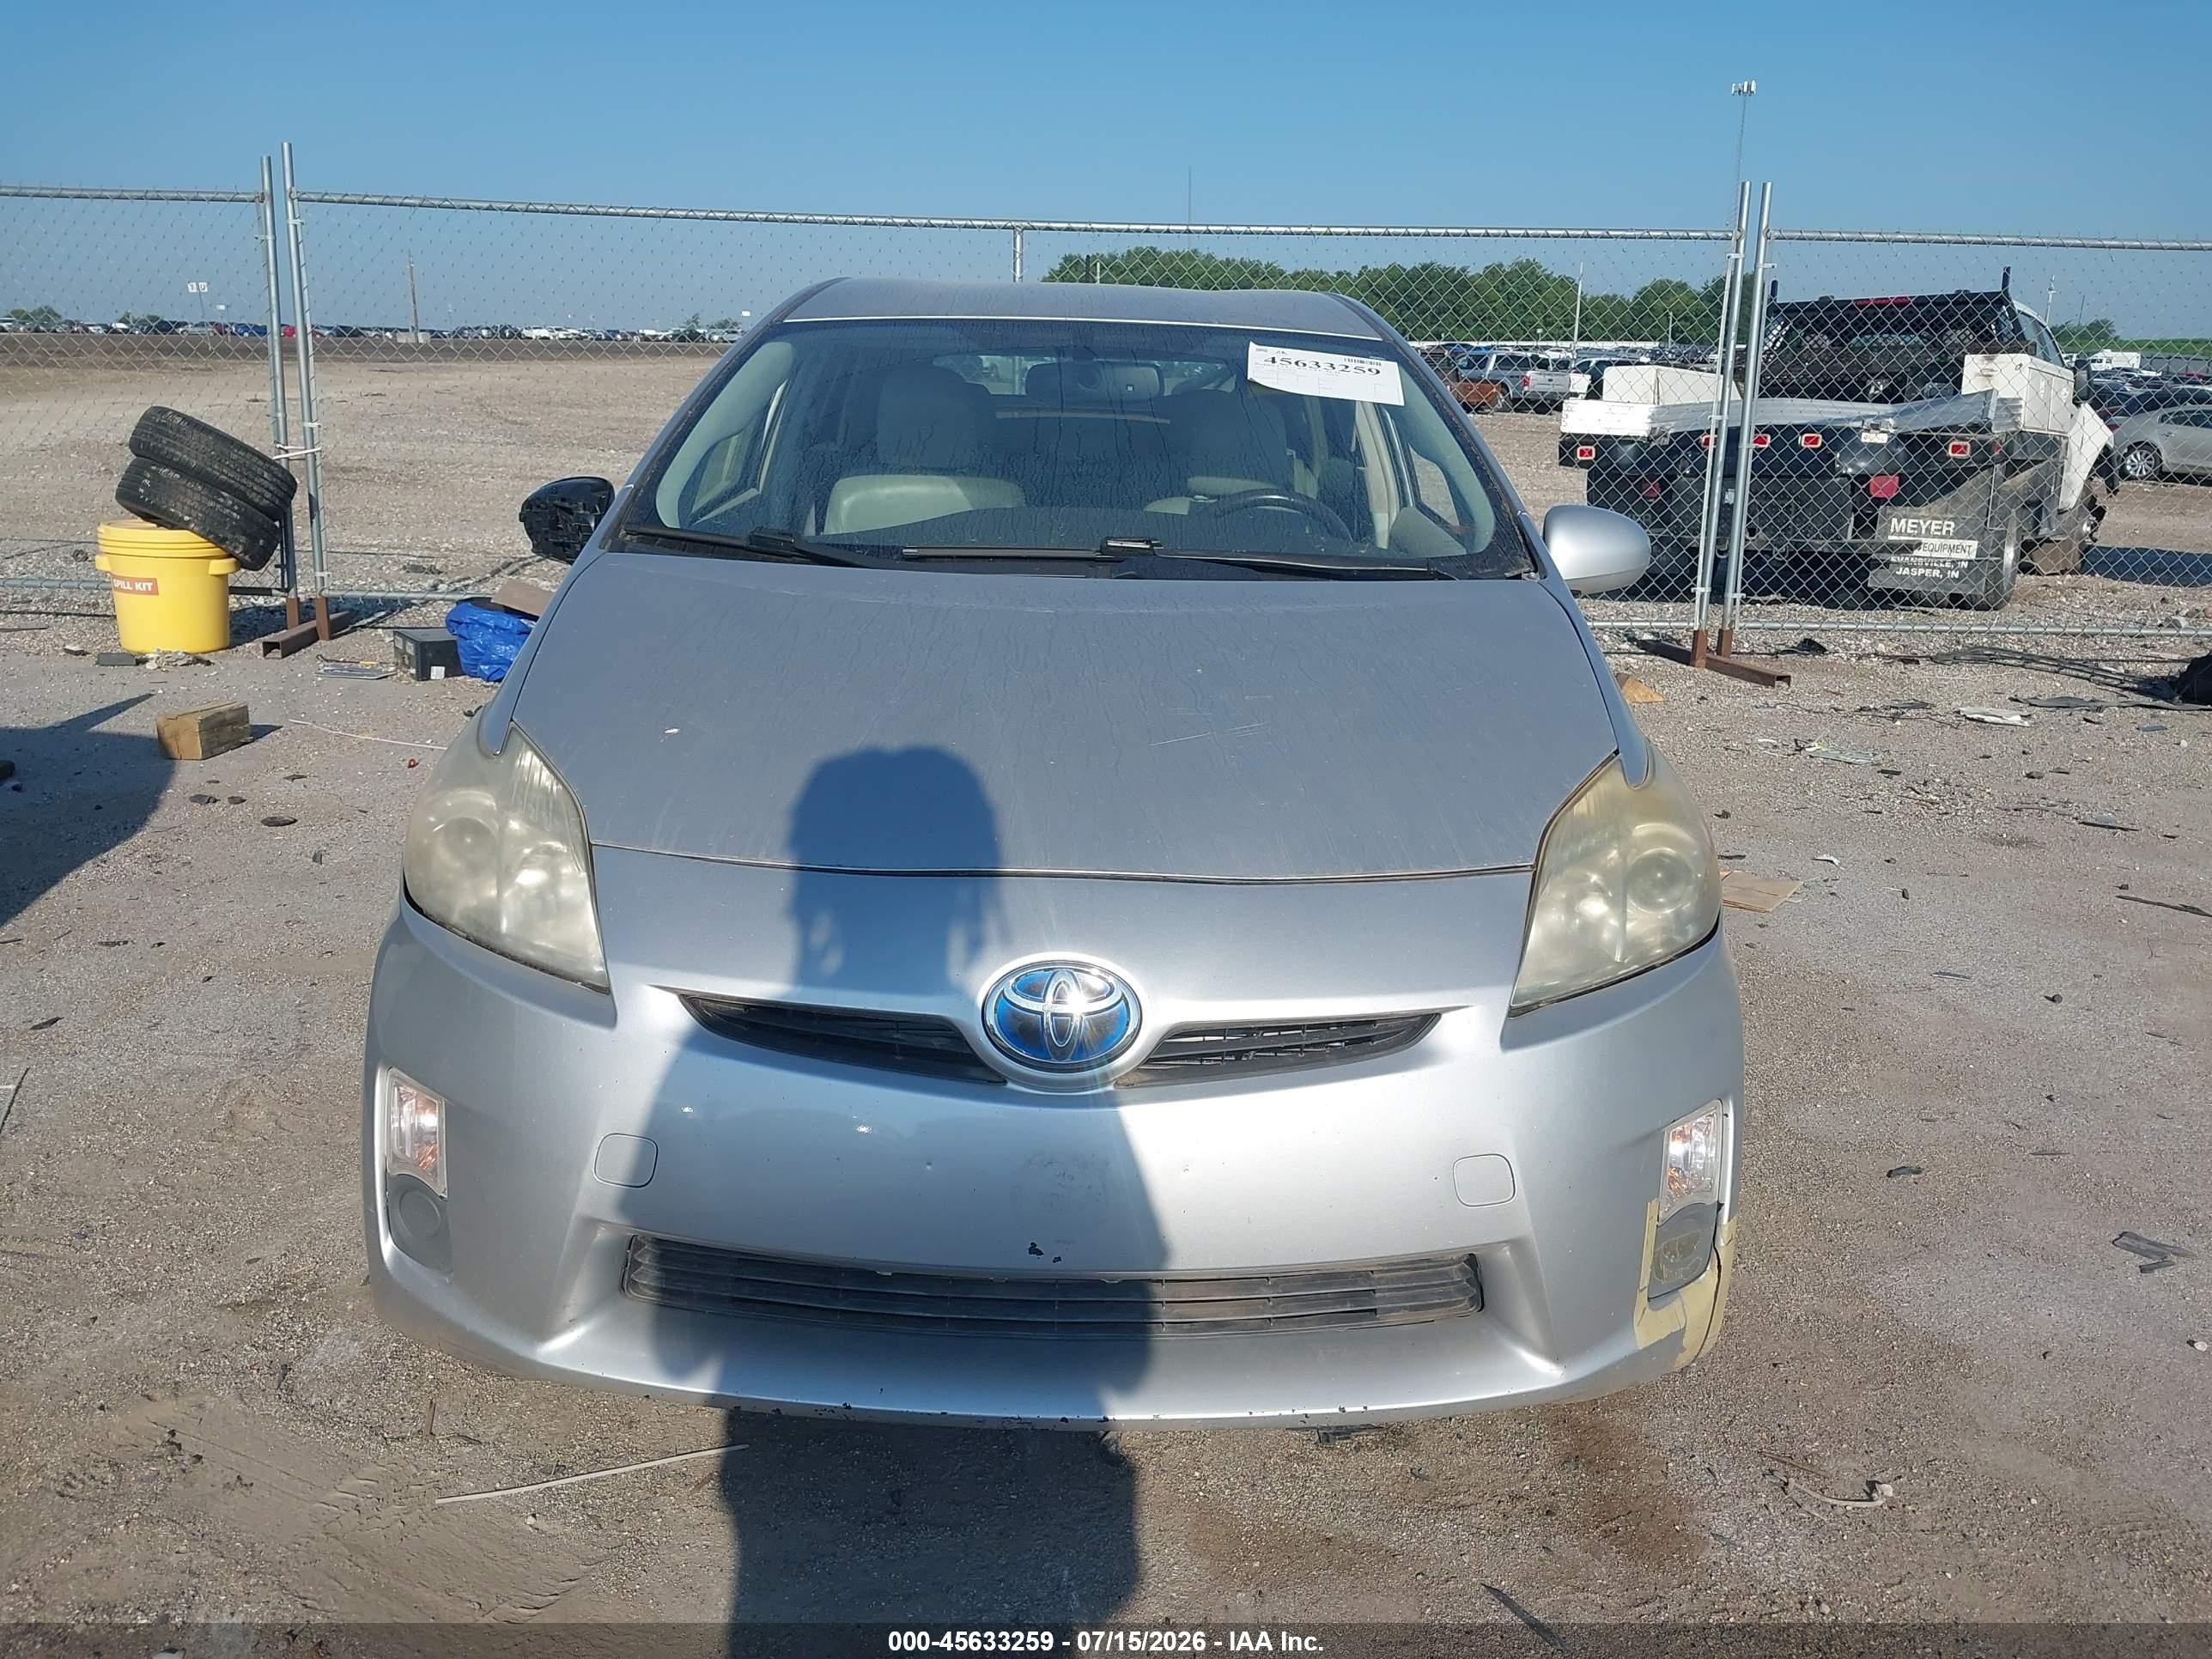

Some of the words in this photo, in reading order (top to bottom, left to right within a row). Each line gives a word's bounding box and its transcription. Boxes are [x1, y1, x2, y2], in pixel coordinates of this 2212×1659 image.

[1264, 356, 1381, 376] 45633259
[1890, 518, 1955, 536] MEYER
[1923, 543, 1972, 554] EQUIPMENT
[1896, 568, 1942, 579] JASPER,
[1947, 569, 1960, 579] IN
[134, 581, 154, 592] KIT
